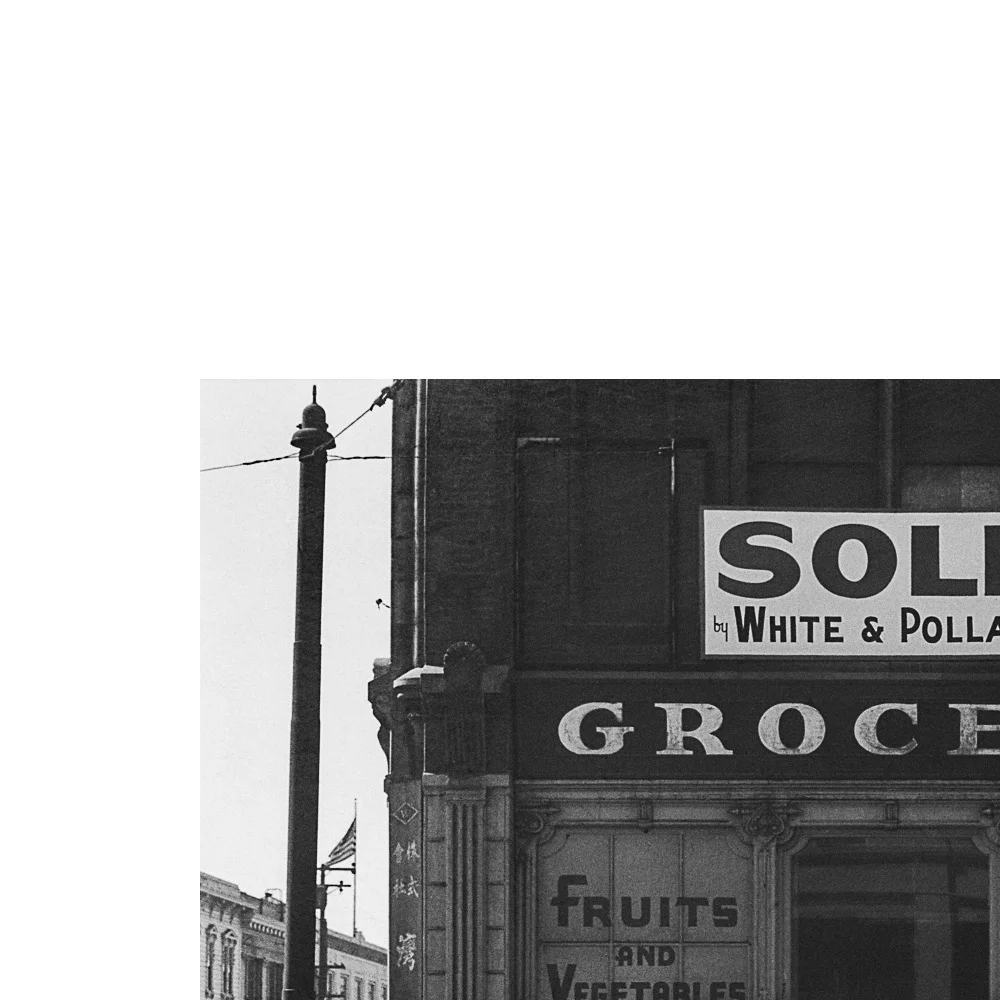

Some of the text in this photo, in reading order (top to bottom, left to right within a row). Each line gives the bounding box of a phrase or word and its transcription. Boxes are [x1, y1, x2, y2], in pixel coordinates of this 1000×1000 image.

[713, 614, 729, 643] by
[733, 605, 844, 644] WHITE
[861, 615, 884, 644] &
[550, 874, 739, 927] FRUITS
[615, 946, 676, 967] AND
